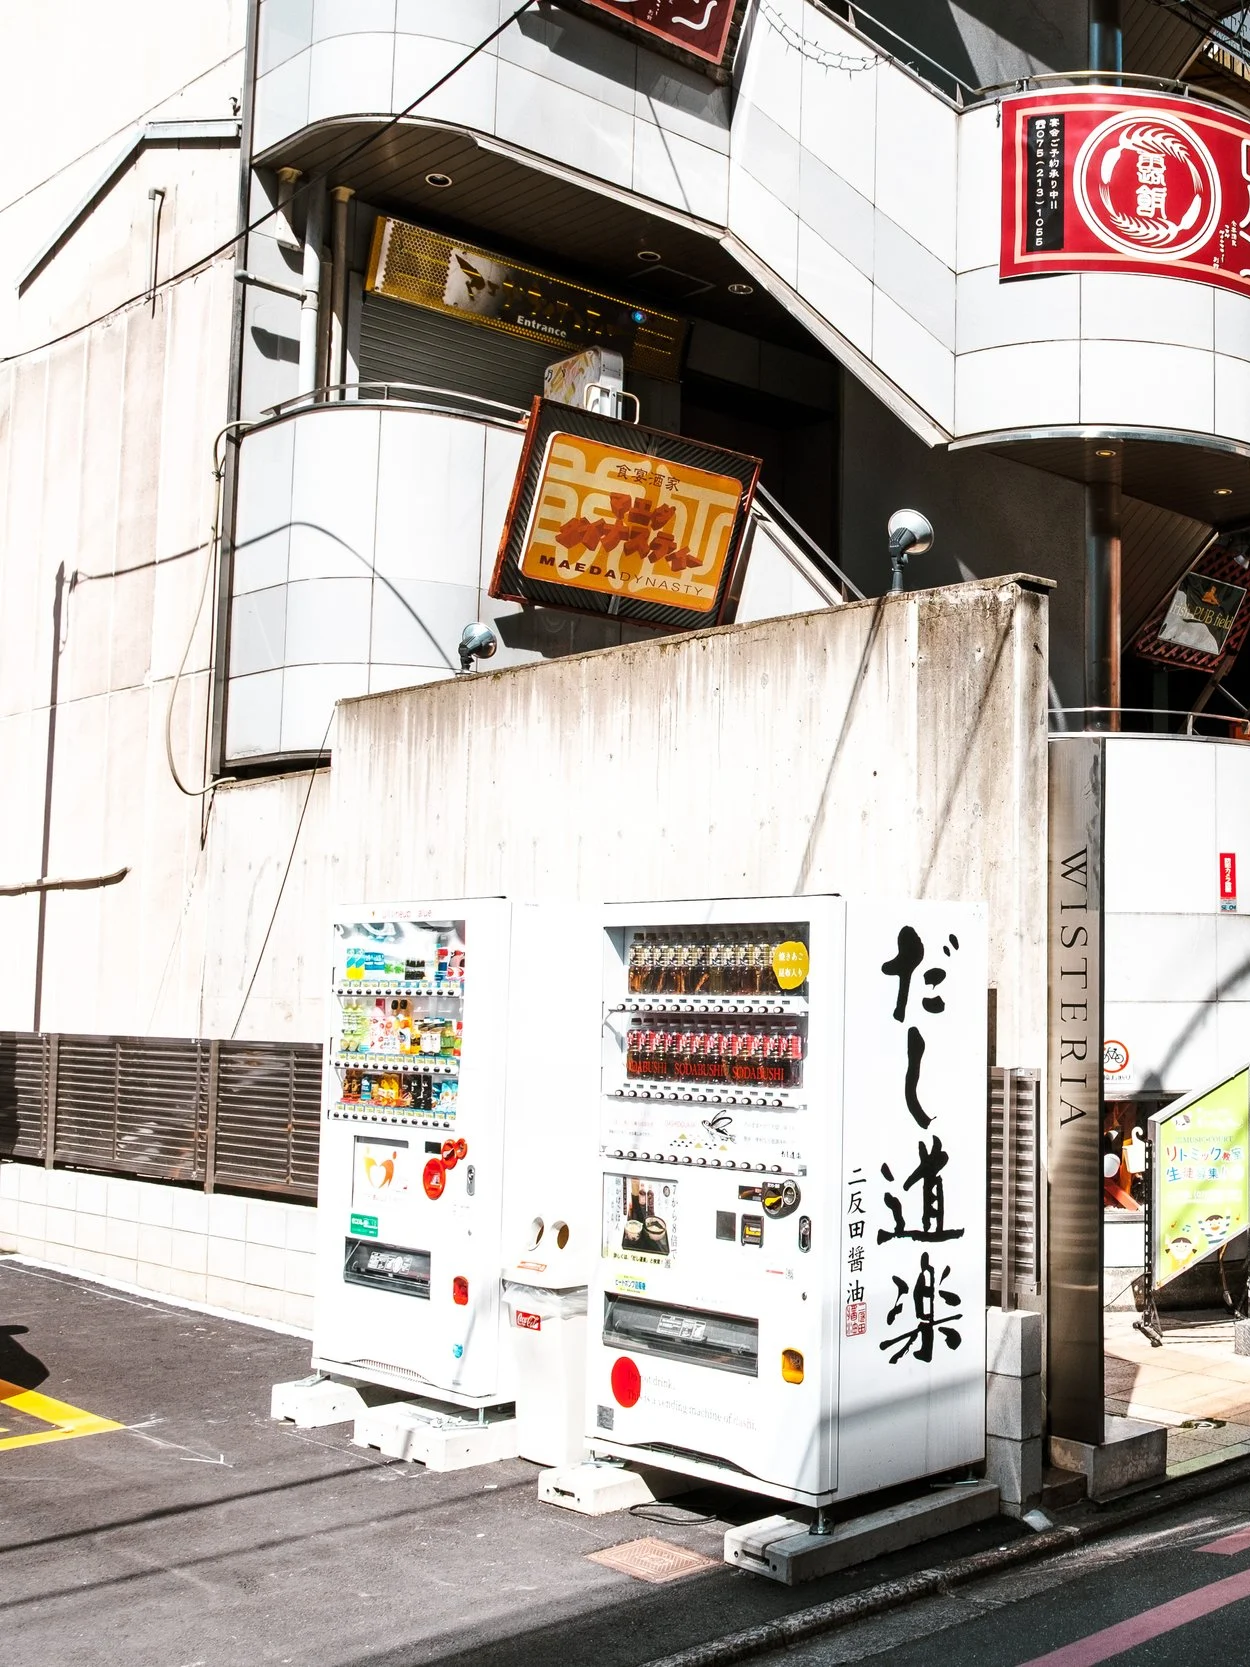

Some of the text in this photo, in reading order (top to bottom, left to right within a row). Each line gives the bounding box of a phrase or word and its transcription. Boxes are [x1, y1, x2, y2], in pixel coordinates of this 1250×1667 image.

[517, 315, 567, 338] Entrance
[1194, 606, 1214, 624] PUB
[1214, 615, 1234, 630] field
[1060, 847, 1088, 1129] WISTERIA
[675, 1063, 722, 1077] SODABUSHI
[732, 1067, 784, 1081] SODABUSHI
[876, 925, 965, 1364] だし道楽
[846, 1167, 867, 1304] 二反田醤油
[657, 1398, 688, 1415] vending
